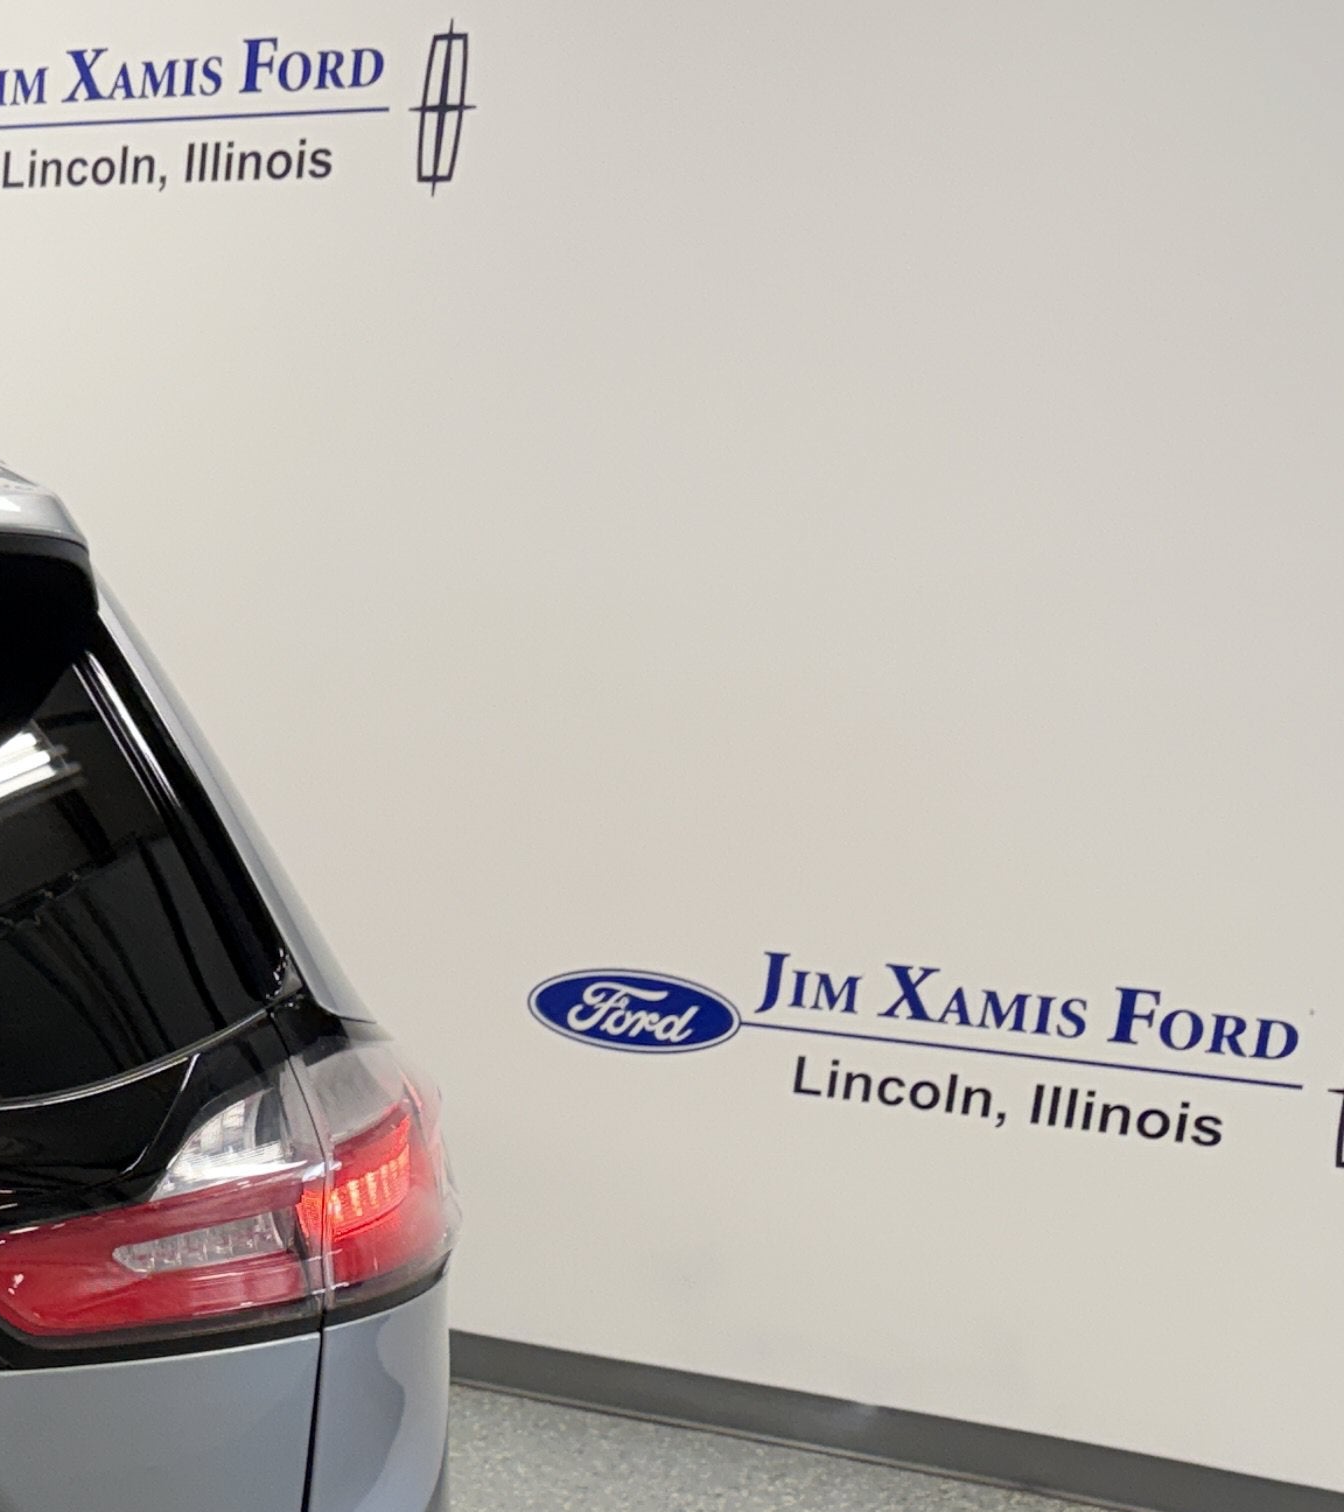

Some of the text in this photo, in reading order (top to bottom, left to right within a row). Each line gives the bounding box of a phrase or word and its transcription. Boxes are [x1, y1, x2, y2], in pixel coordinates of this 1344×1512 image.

[61, 47, 223, 103] XAMIS
[238, 37, 385, 96] FORD
[1, 138, 334, 191] Lincoln, Illinois
[566, 981, 694, 1044] Ford
[754, 950, 1301, 1062] JIM XAMIS FORD
[792, 1055, 1225, 1148] Lincoln, Illinois
